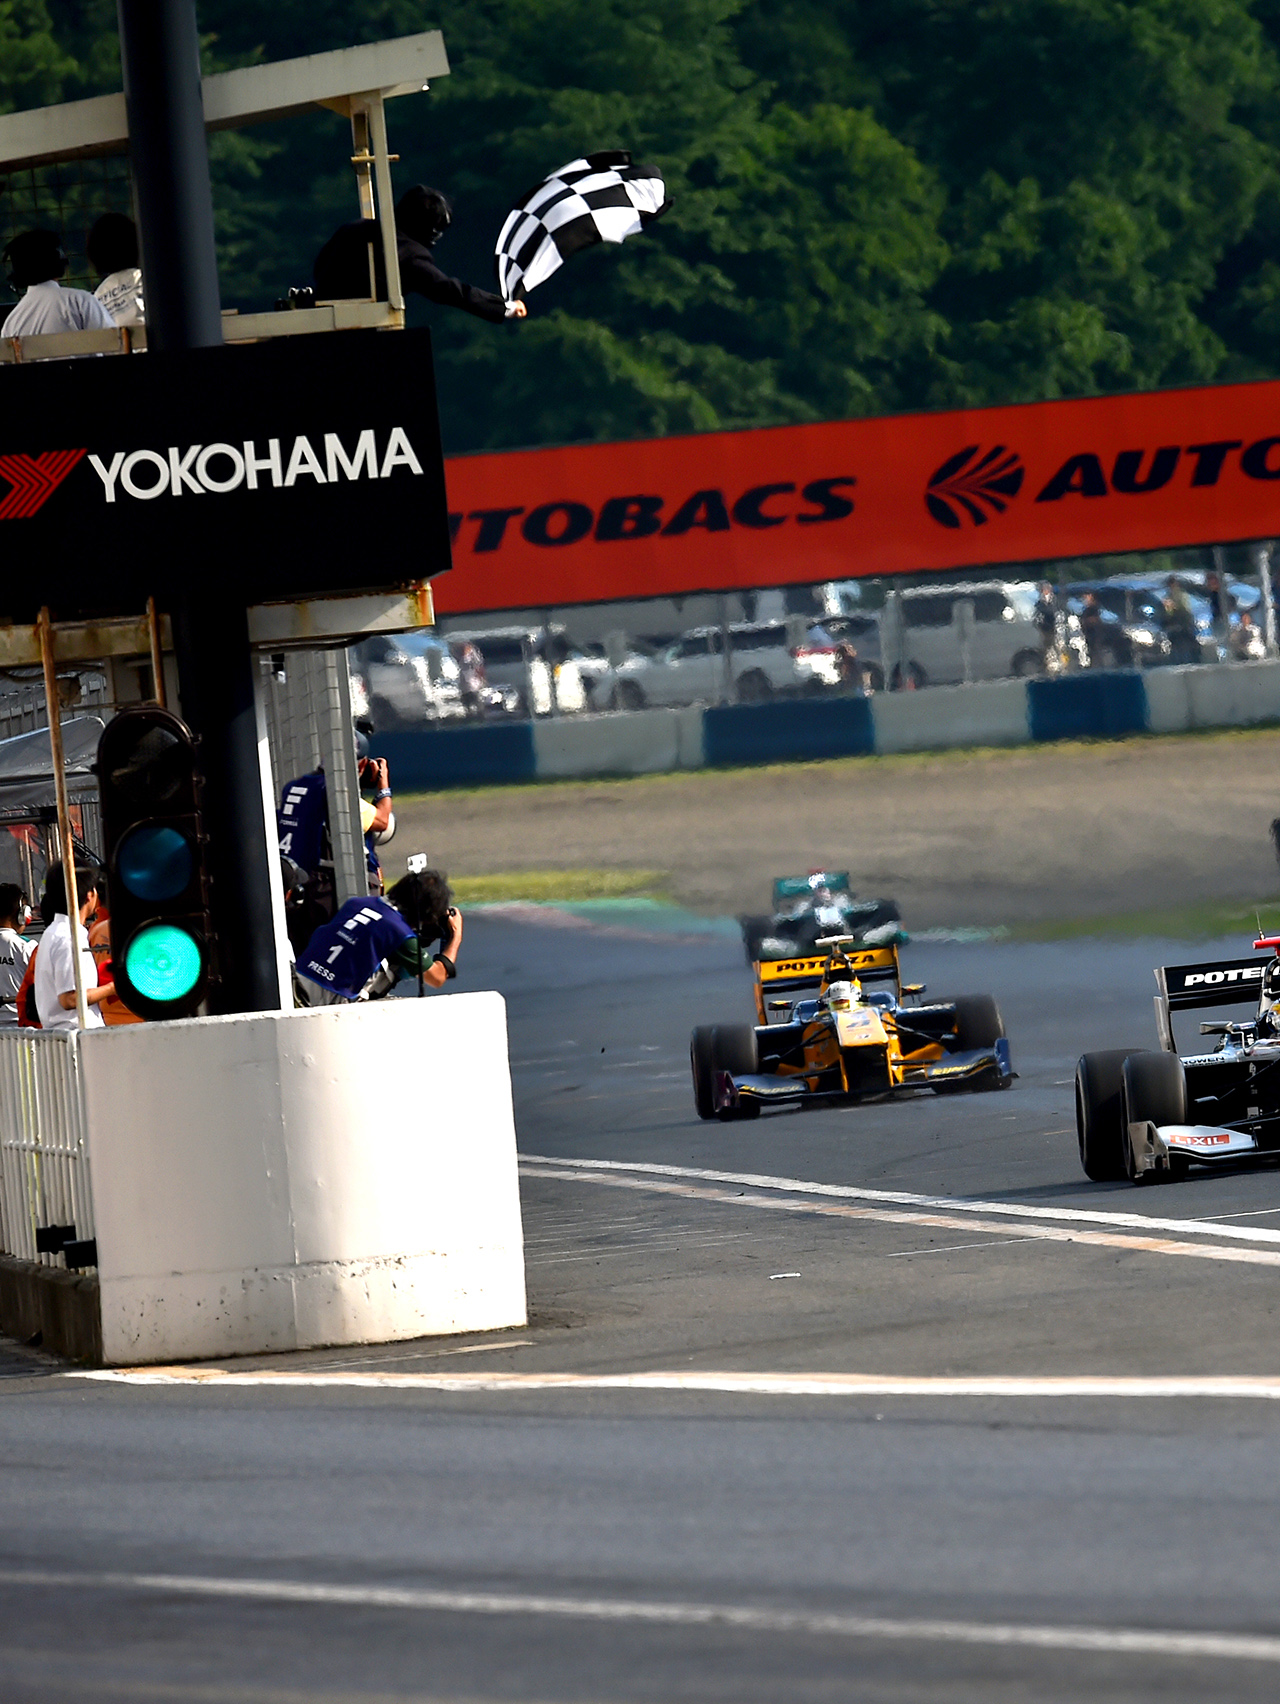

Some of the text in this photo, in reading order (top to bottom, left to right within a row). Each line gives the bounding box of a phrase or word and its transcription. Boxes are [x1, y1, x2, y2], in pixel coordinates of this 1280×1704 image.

[88, 427, 424, 502] YOKOHAMA
[326, 945, 344, 964] 1
[307, 960, 335, 981] PRESS
[1174, 1135, 1225, 1145] LIXIL
